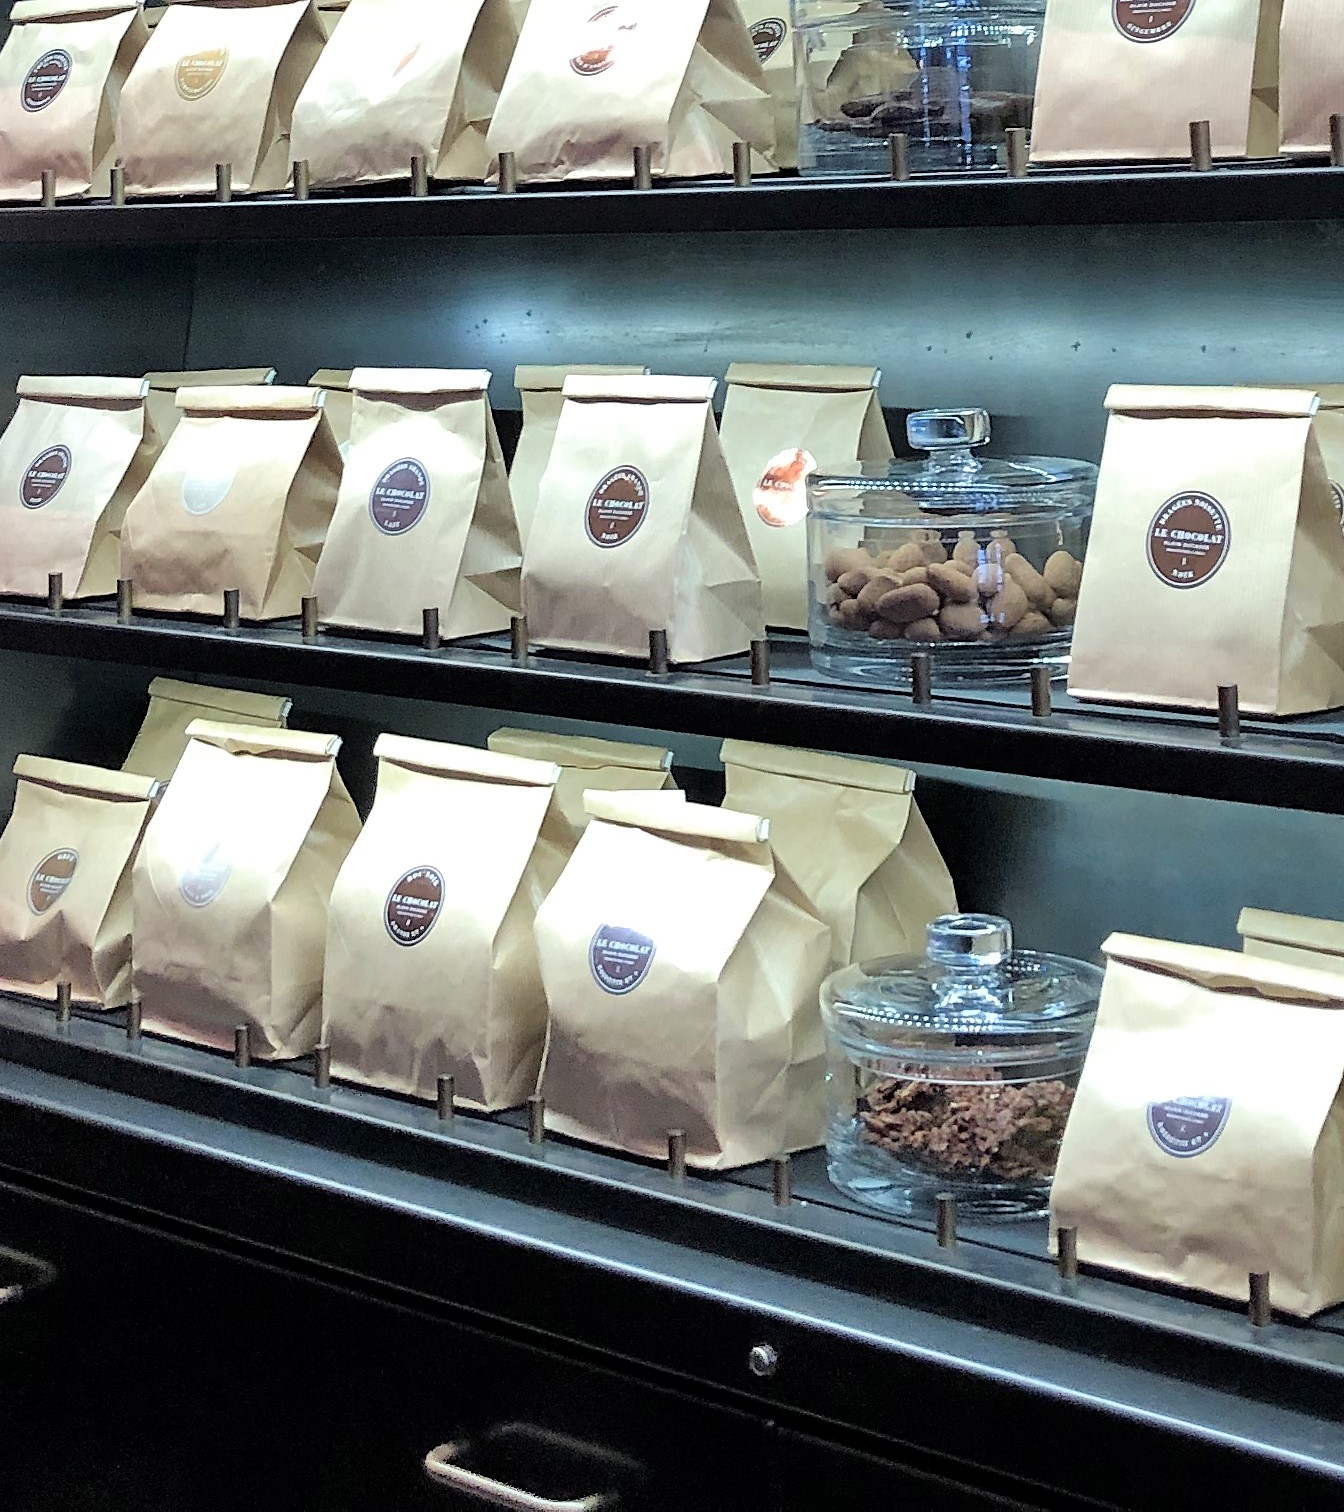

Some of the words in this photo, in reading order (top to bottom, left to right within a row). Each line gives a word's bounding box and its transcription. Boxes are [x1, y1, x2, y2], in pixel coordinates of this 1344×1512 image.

[375, 486, 387, 496] LE
[386, 487, 425, 500] CHOCOLAT
[592, 498, 604, 508] LE
[604, 499, 646, 511] CHOCOLAT
[1154, 527, 1169, 538] LE
[1170, 529, 1225, 545] CHOCOLAT
[391, 893, 403, 903] LE
[402, 895, 440, 910] CHOCOLAT
[596, 938, 608, 948] LE
[608, 940, 651, 955] CHOCOLAT
